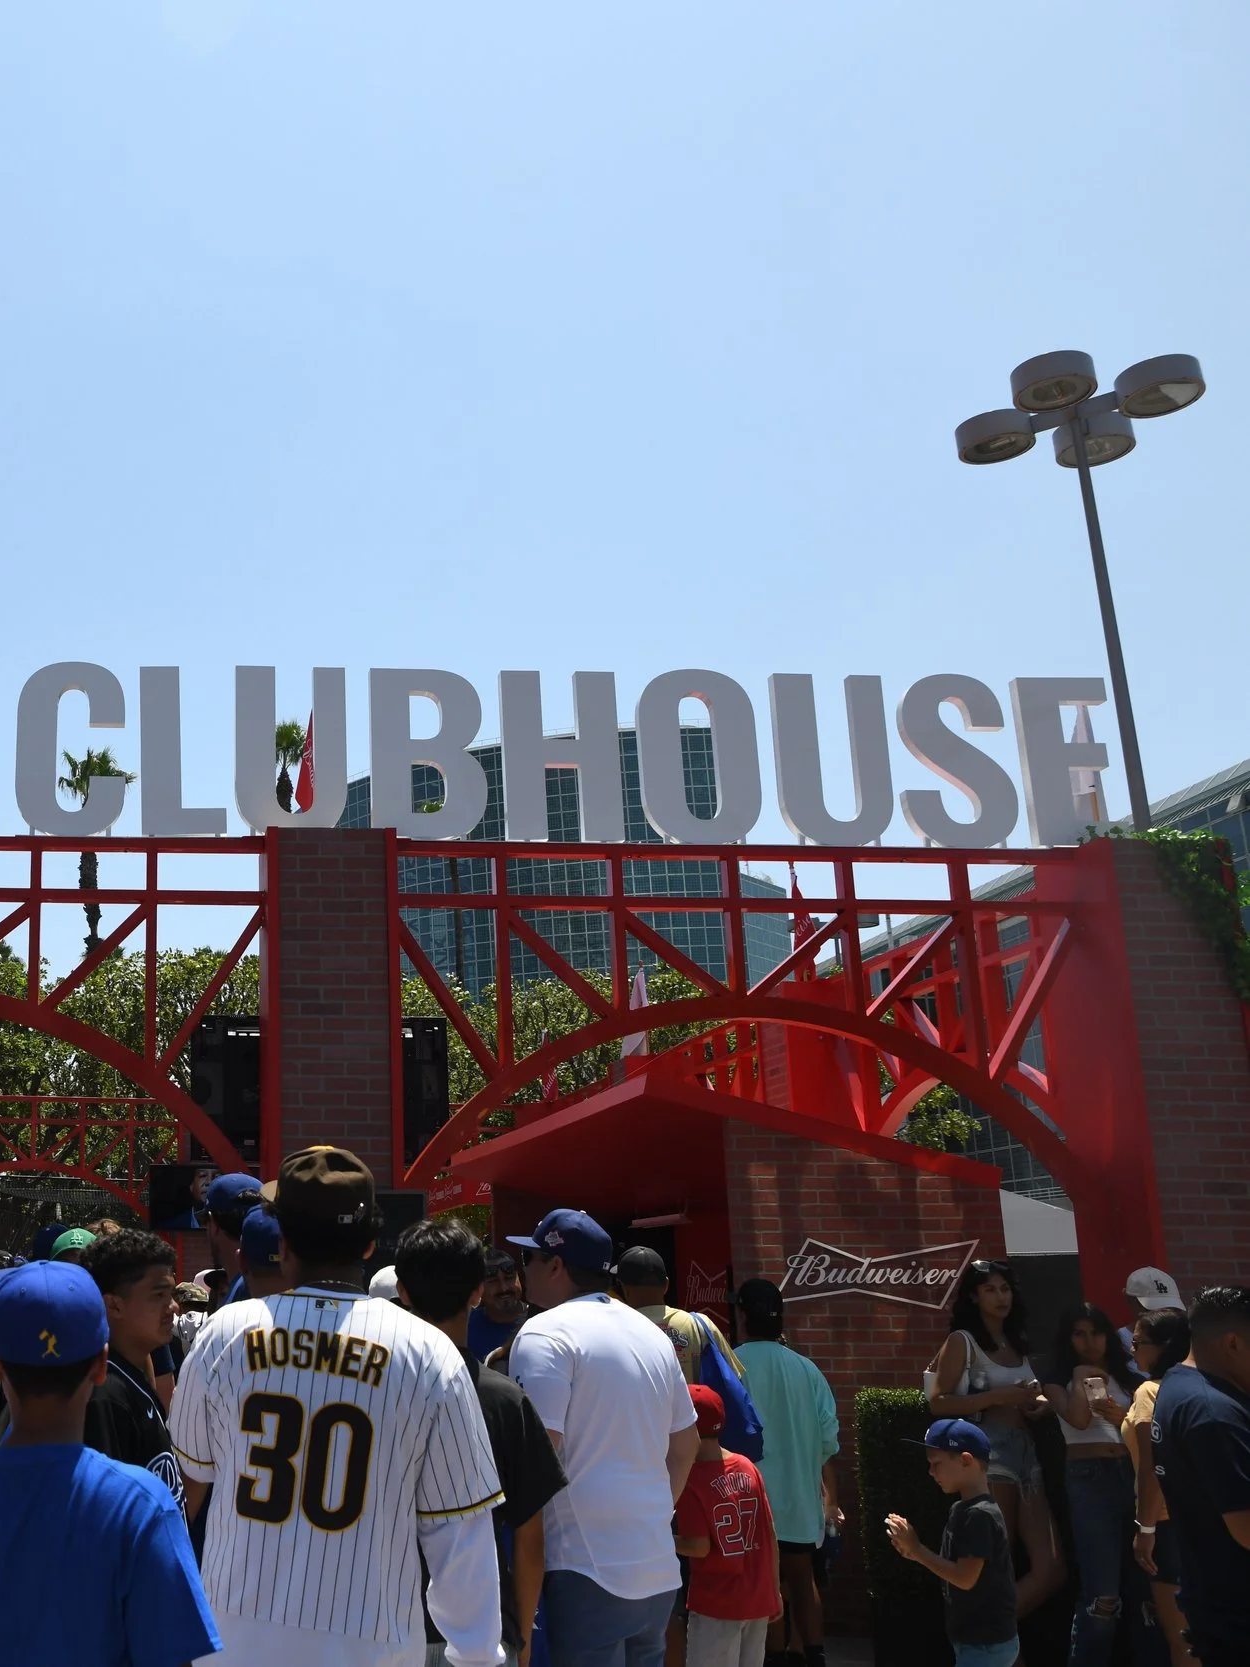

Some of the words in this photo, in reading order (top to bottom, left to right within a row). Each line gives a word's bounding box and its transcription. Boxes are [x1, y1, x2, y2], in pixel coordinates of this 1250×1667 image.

[15, 660, 1110, 848] CLUBHOUSE
[786, 1254, 959, 1286] Budweiser
[1153, 1280, 1168, 1294] LA
[245, 1327, 391, 1388] HOSMER
[235, 1391, 375, 1534] 30
[710, 1472, 752, 1499] TROUT
[713, 1497, 758, 1556] 27
